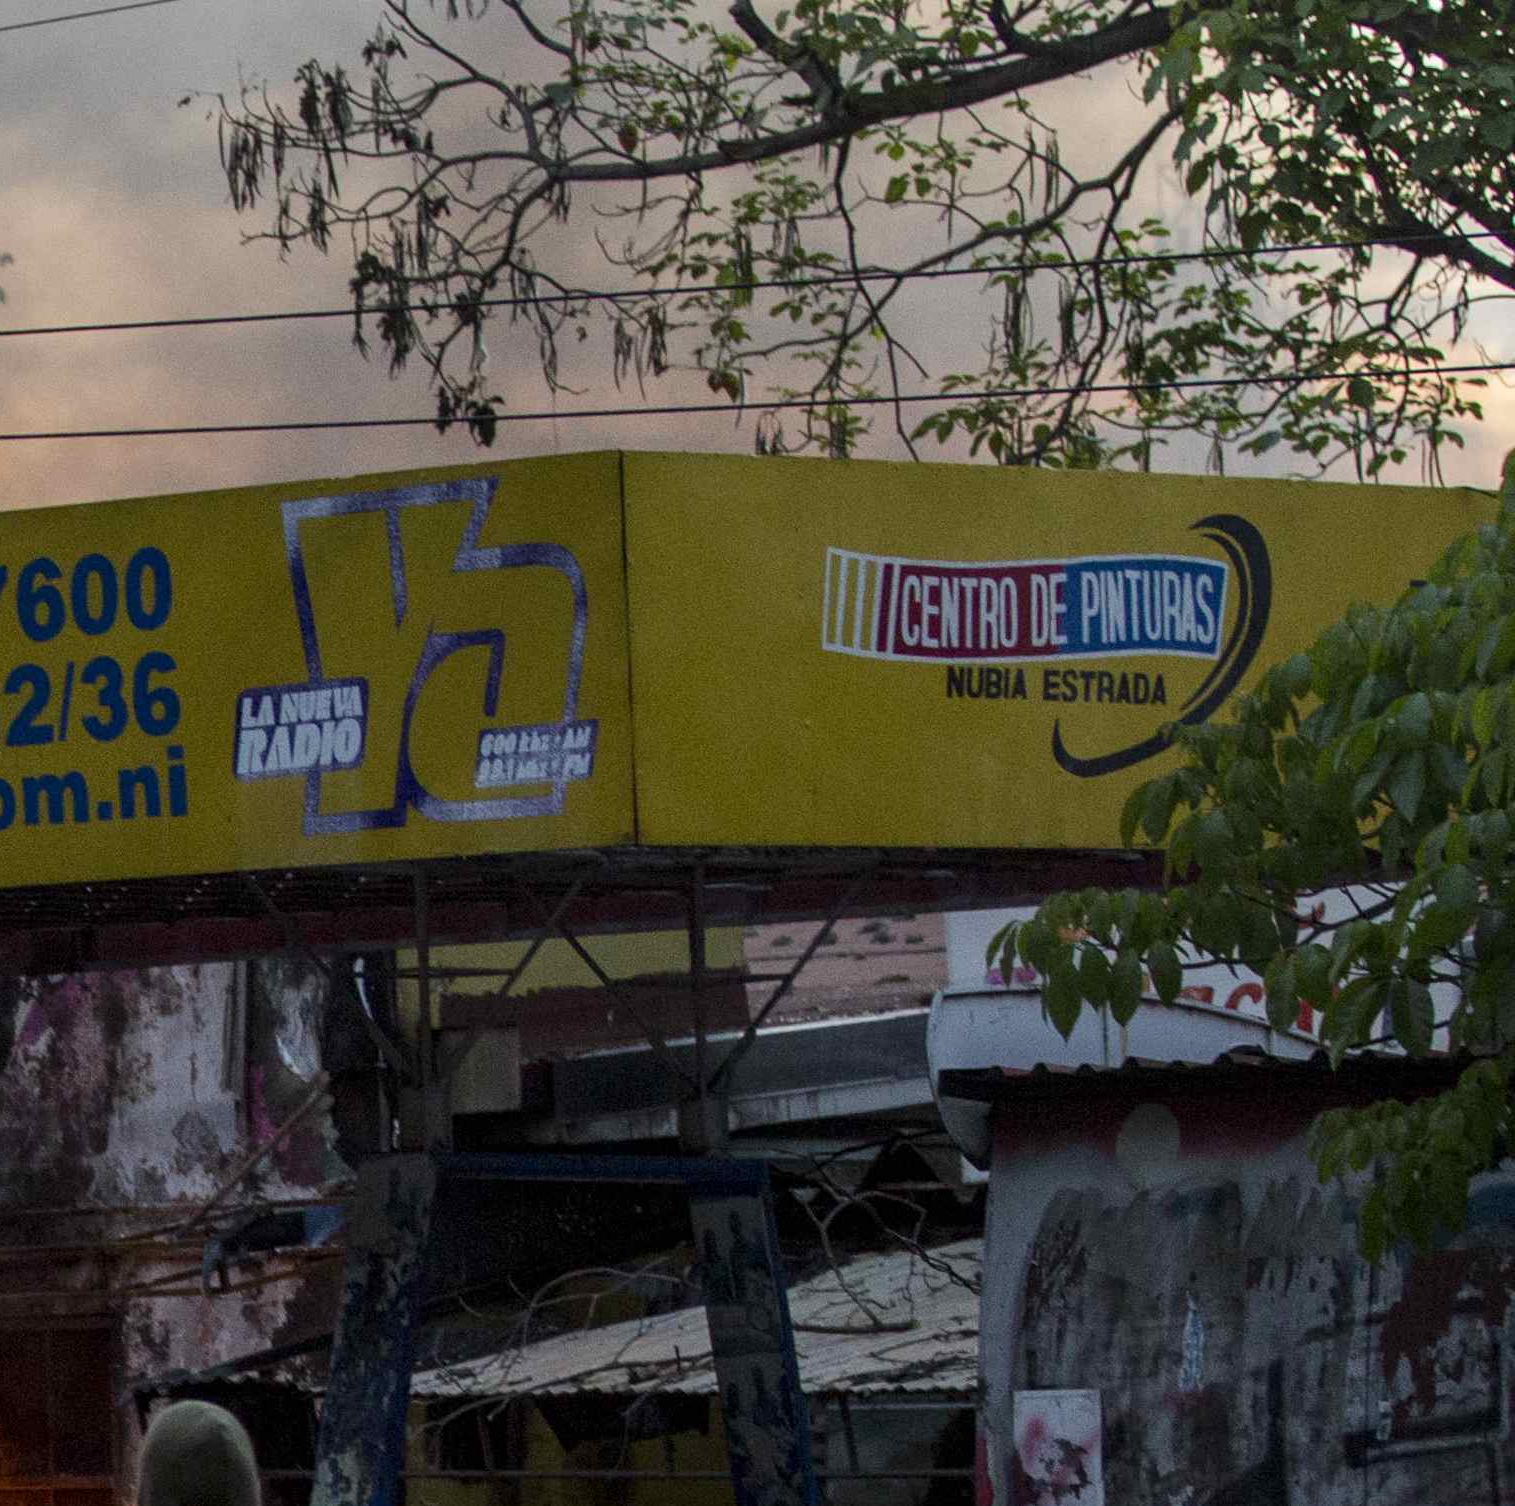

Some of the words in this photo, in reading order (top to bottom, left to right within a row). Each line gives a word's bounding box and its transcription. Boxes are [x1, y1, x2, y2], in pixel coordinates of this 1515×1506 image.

[899, 574, 1019, 650] CENTRO
[1030, 571, 1068, 647] DE
[1080, 568, 1217, 646] PINTURAS
[240, 694, 276, 728] LA
[279, 685, 364, 725] NUEVA
[944, 665, 1028, 702] NUBIA
[1041, 668, 1167, 707] ESTRADA
[236, 717, 363, 775] RADIO
